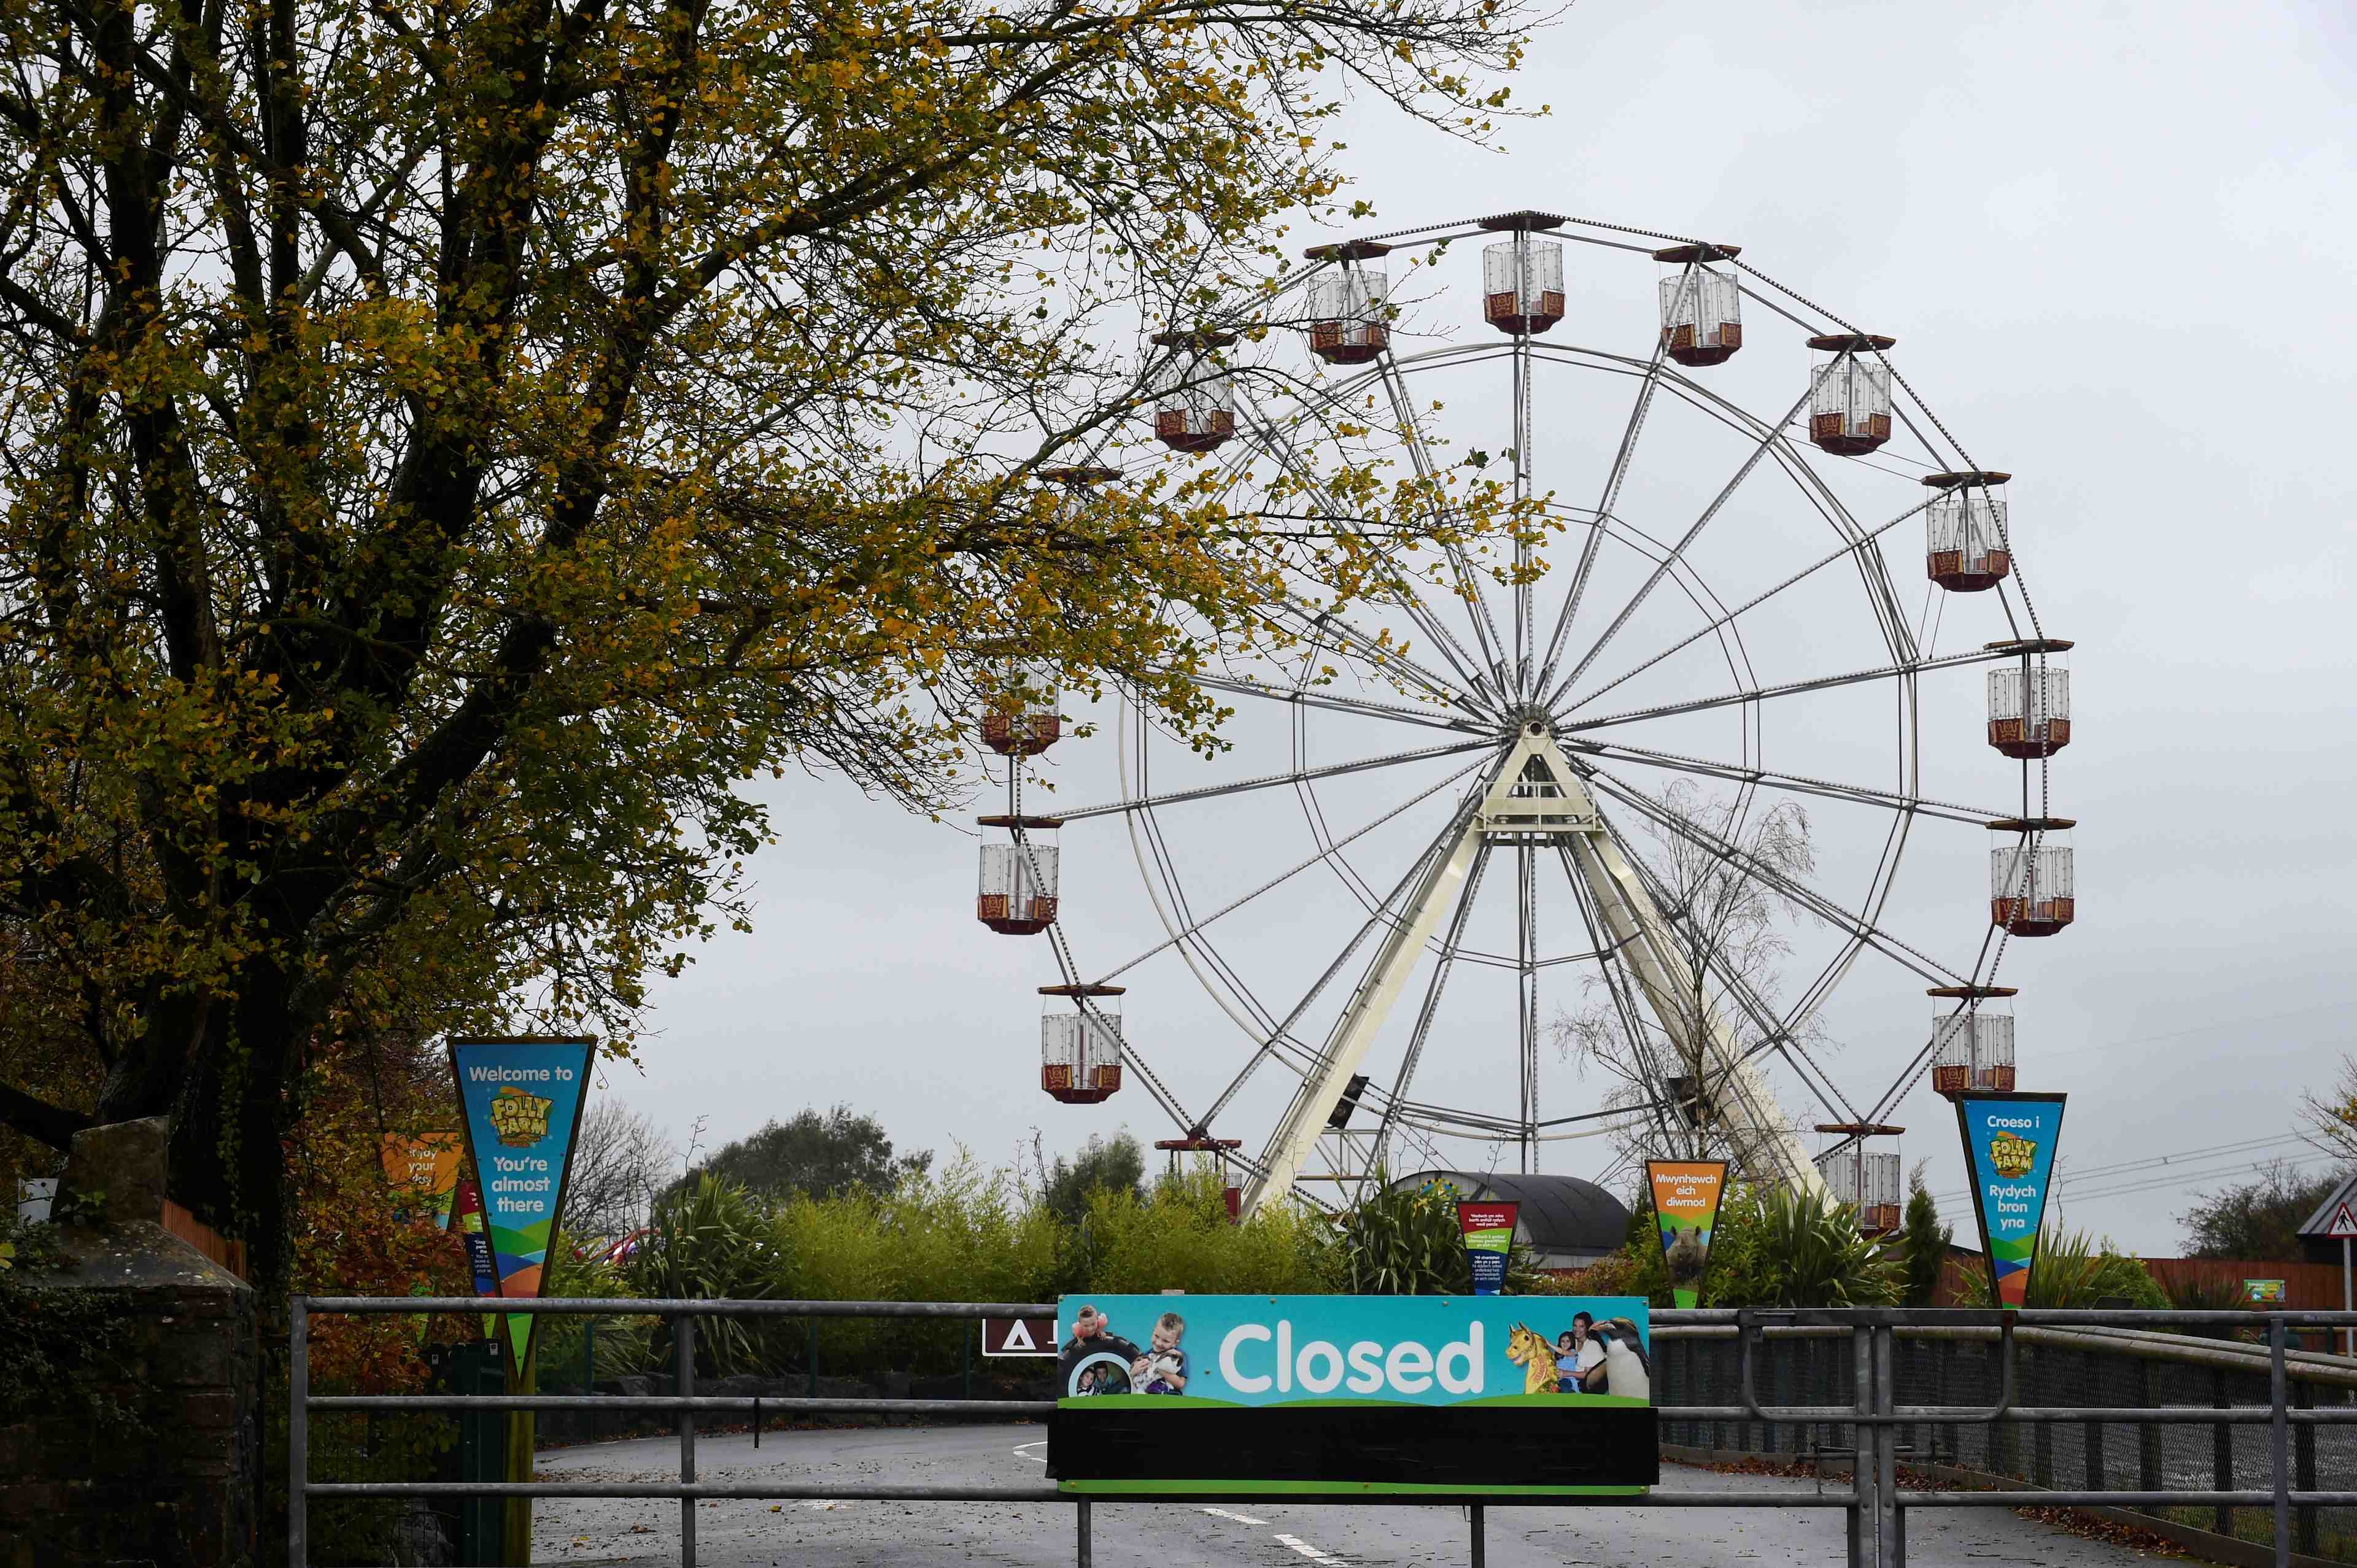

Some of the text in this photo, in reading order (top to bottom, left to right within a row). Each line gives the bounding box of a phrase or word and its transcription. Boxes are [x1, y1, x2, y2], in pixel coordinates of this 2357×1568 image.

[470, 1066, 573, 1081] Welcome to
[490, 1095, 554, 1121] FOLLY
[496, 1118, 548, 1136] FARM
[1987, 1115, 2039, 1128] Croeso i
[1990, 1139, 2038, 1158] FOLLY
[408, 1162, 435, 1174] your
[493, 1156, 548, 1172] You're
[1994, 1155, 2033, 1170] FARM
[492, 1176, 550, 1192] almost
[1656, 1174, 1716, 1186] Mwynhewch
[1676, 1186, 1695, 1195] eich
[1990, 1184, 2036, 1198] Rydych
[497, 1196, 544, 1212] there
[1998, 1199, 2027, 1213] bron
[2000, 1218, 2025, 1230] yna
[1219, 1319, 1484, 1394] Closed
